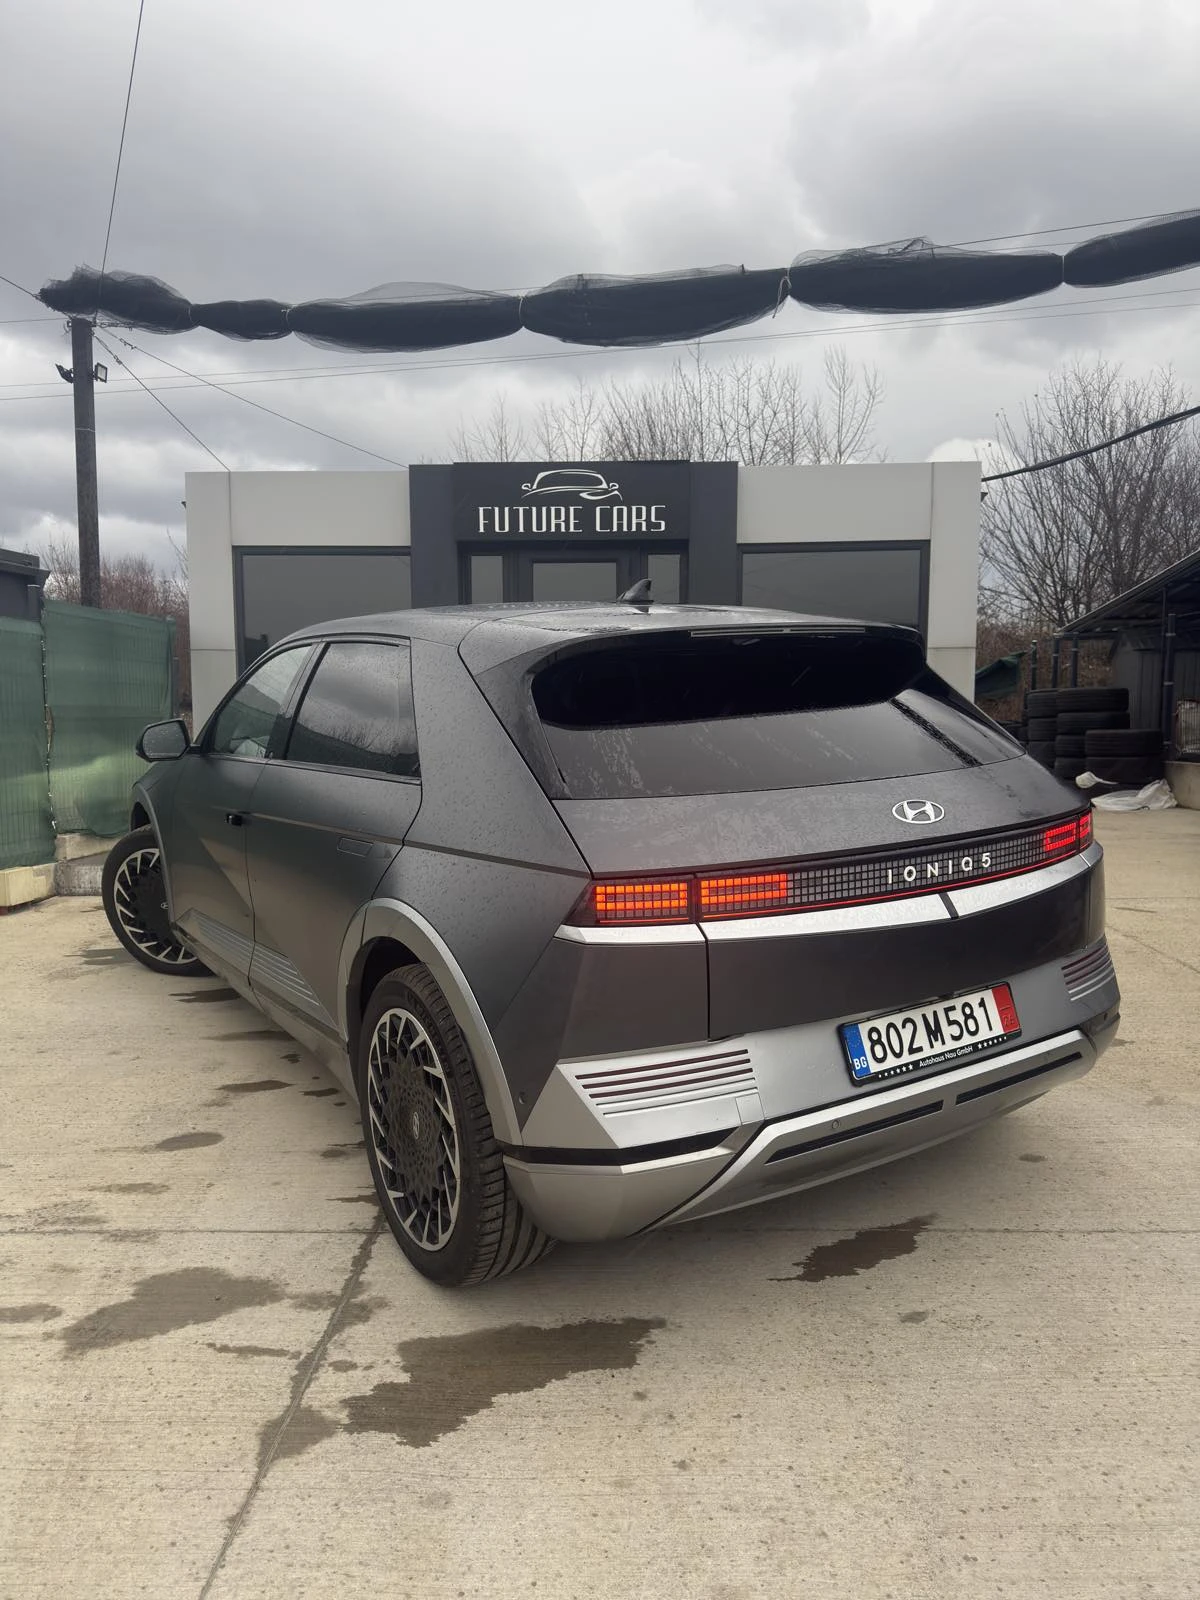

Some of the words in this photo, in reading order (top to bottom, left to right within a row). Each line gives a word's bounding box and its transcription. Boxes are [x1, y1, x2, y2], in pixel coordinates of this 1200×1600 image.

[478, 506, 583, 533] FUTURE
[595, 505, 666, 532] CARS
[853, 1055, 868, 1070] BG
[919, 1056, 945, 1067] Autohaus
[956, 1045, 974, 1056] GmbH
